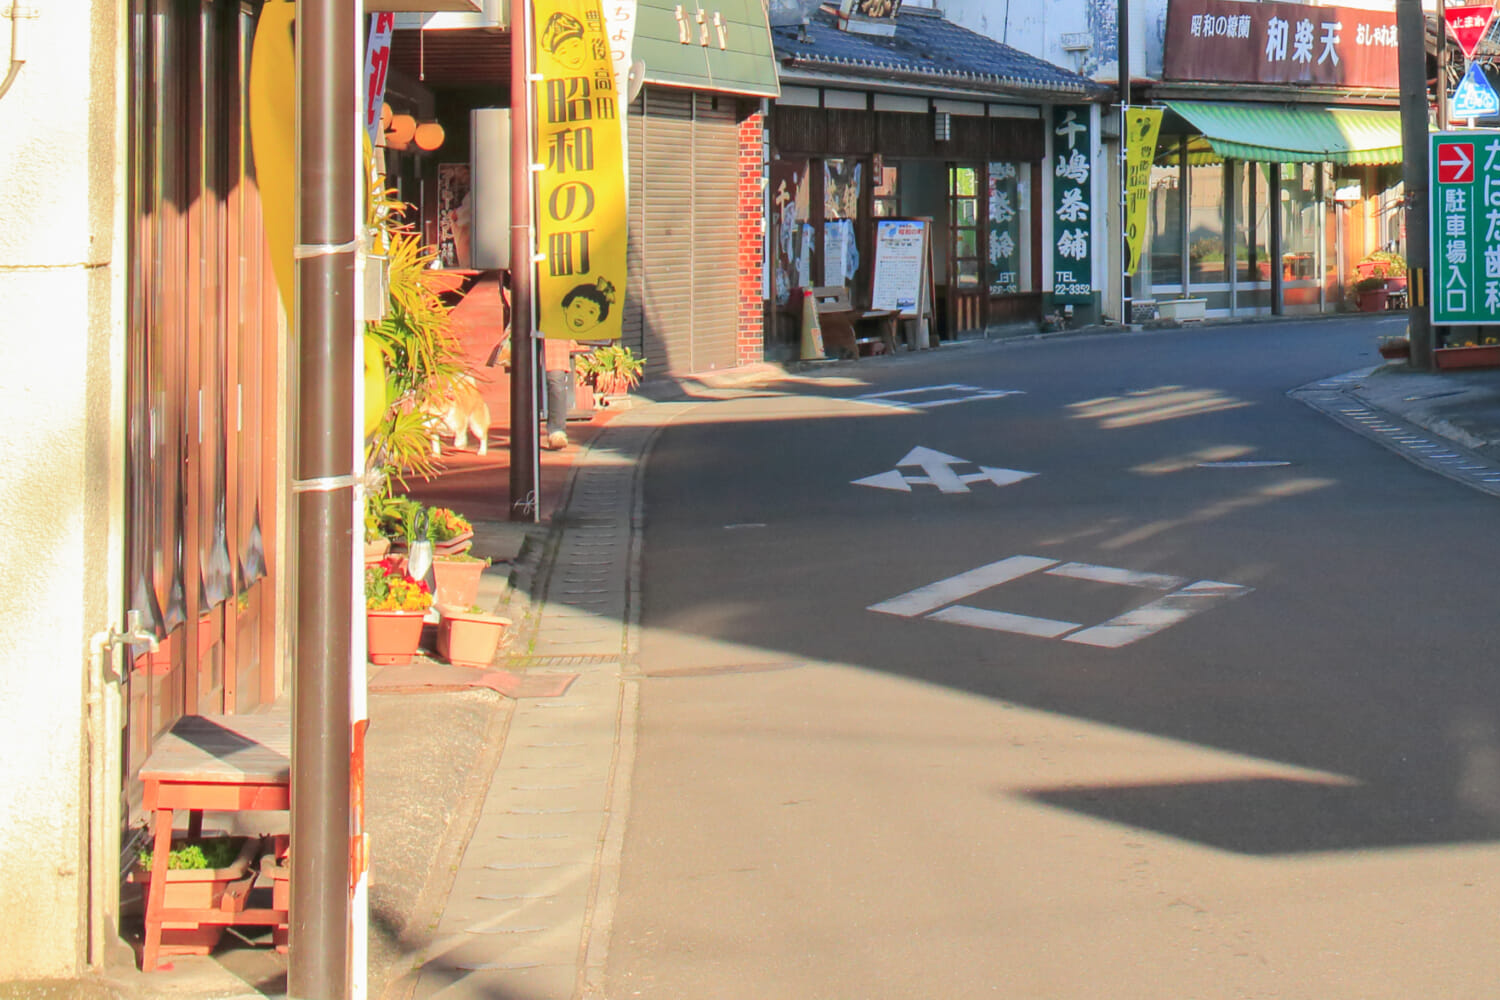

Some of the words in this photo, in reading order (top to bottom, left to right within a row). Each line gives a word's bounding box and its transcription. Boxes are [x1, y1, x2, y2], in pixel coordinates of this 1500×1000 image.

[1265, 15, 1343, 67] 和楽天
[1452, 15, 1485, 29] 止まれ
[585, 9, 615, 120] 豊後高田
[545, 76, 596, 277] 昭和の町
[1445, 188, 1467, 312] 駐車場入口
[1054, 284, 1091, 295] 22-3352
[1055, 271, 1078, 283] TEL
